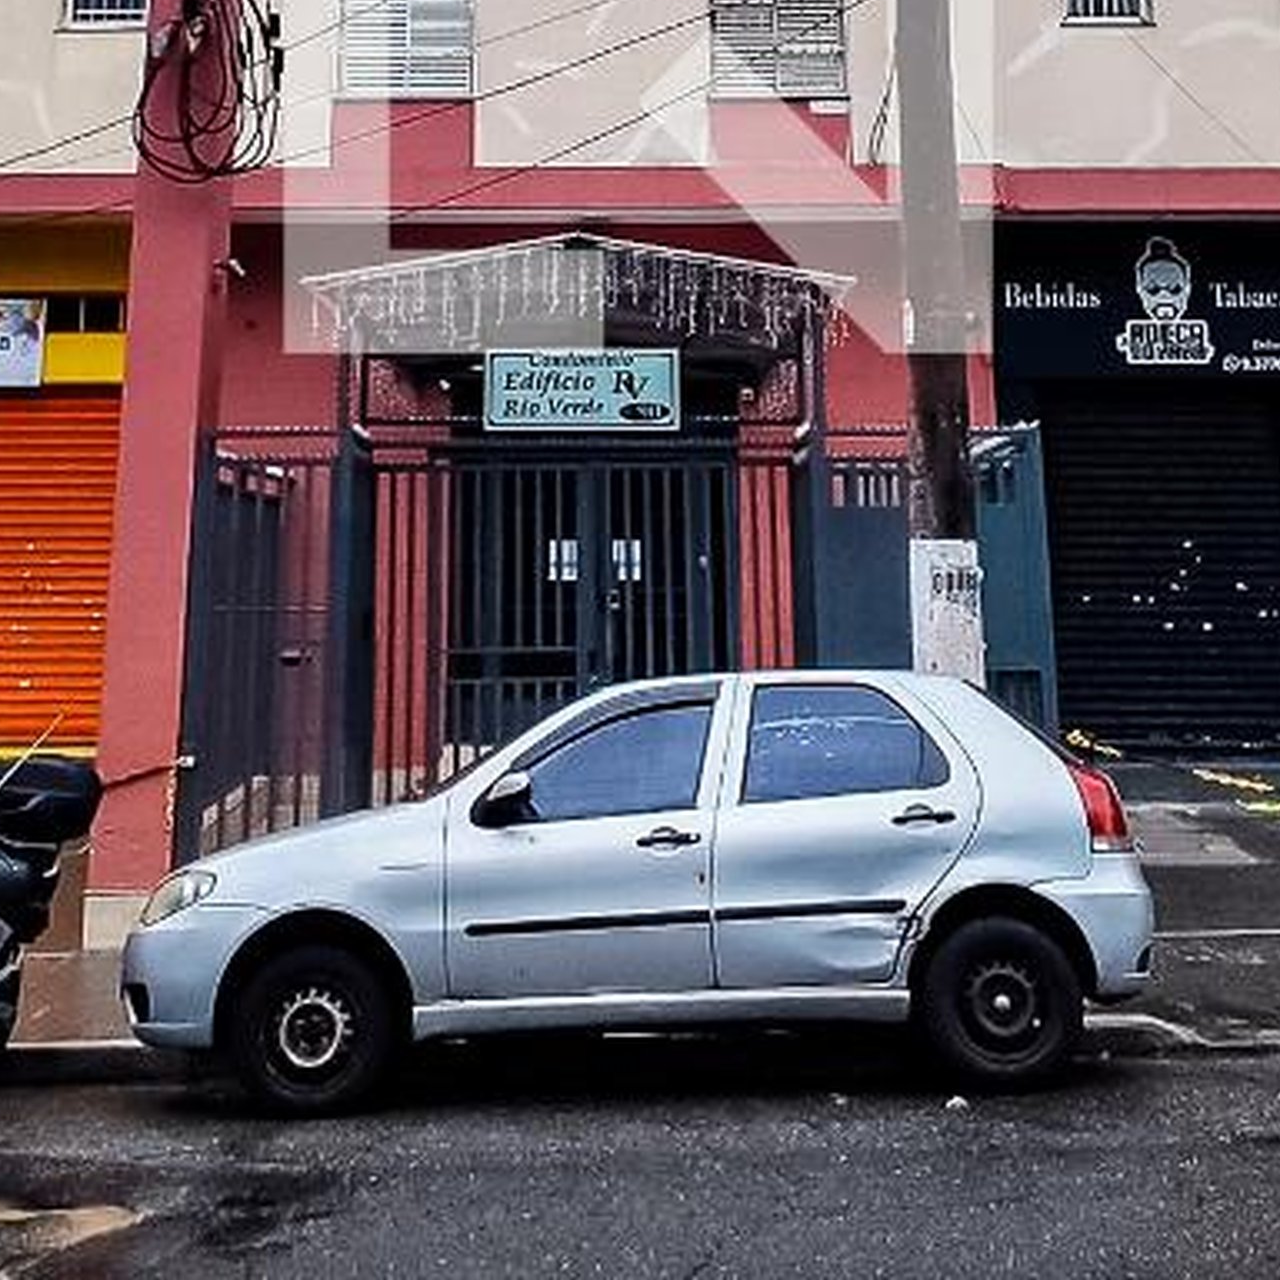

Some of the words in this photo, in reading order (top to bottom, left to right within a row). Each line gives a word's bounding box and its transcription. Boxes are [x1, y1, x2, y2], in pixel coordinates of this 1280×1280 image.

[1004, 283, 1101, 308] Bebidas
[503, 399, 542, 417] Rio
[548, 398, 605, 417] Verde
